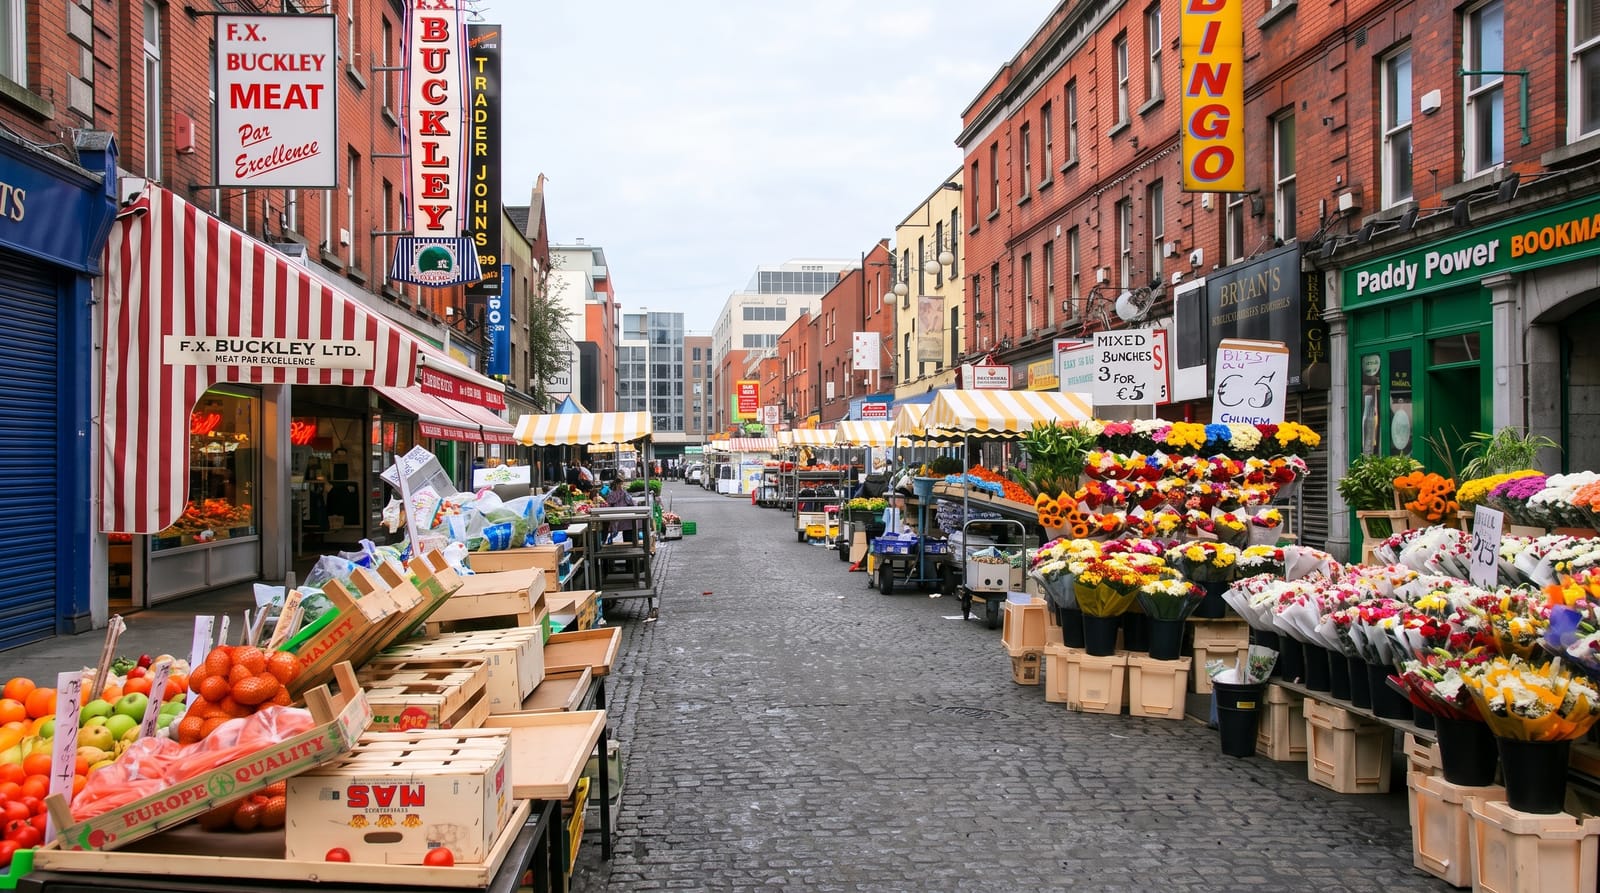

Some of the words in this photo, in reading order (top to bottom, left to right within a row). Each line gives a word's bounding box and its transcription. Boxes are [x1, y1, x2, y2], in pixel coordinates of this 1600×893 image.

[226, 23, 267, 42] F.X.
[227, 53, 326, 72] BUCKLEY
[230, 83, 324, 110] MEAT
[475, 57, 488, 156] TRADER
[238, 123, 271, 147] Par
[418, 17, 452, 231] BUCKLEY
[234, 141, 320, 179] Excellence
[475, 165, 488, 246] JOHNS
[1357, 260, 1418, 297] Paddy
[1425, 239, 1500, 280] Power
[1511, 213, 1600, 258] BOOKMA
[1220, 266, 1281, 308] BRYAN'S
[180, 341, 211, 352] F.X.
[215, 339, 316, 356] BUCKLEY
[322, 345, 361, 357] LTD.
[1097, 335, 1146, 347] MIXED
[215, 354, 239, 363] MEAT
[241, 356, 258, 364] PAR
[261, 356, 315, 366] EXCELLENCE
[1101, 351, 1152, 363] BUNCHES
[1098, 366, 1111, 381] 3
[1113, 374, 1136, 384] FOR
[1116, 383, 1146, 400] €5
[1217, 371, 1276, 408] €5
[122, 784, 208, 829] EUROPE
[235, 735, 325, 784] QUALITY
[347, 784, 426, 808] MAS
